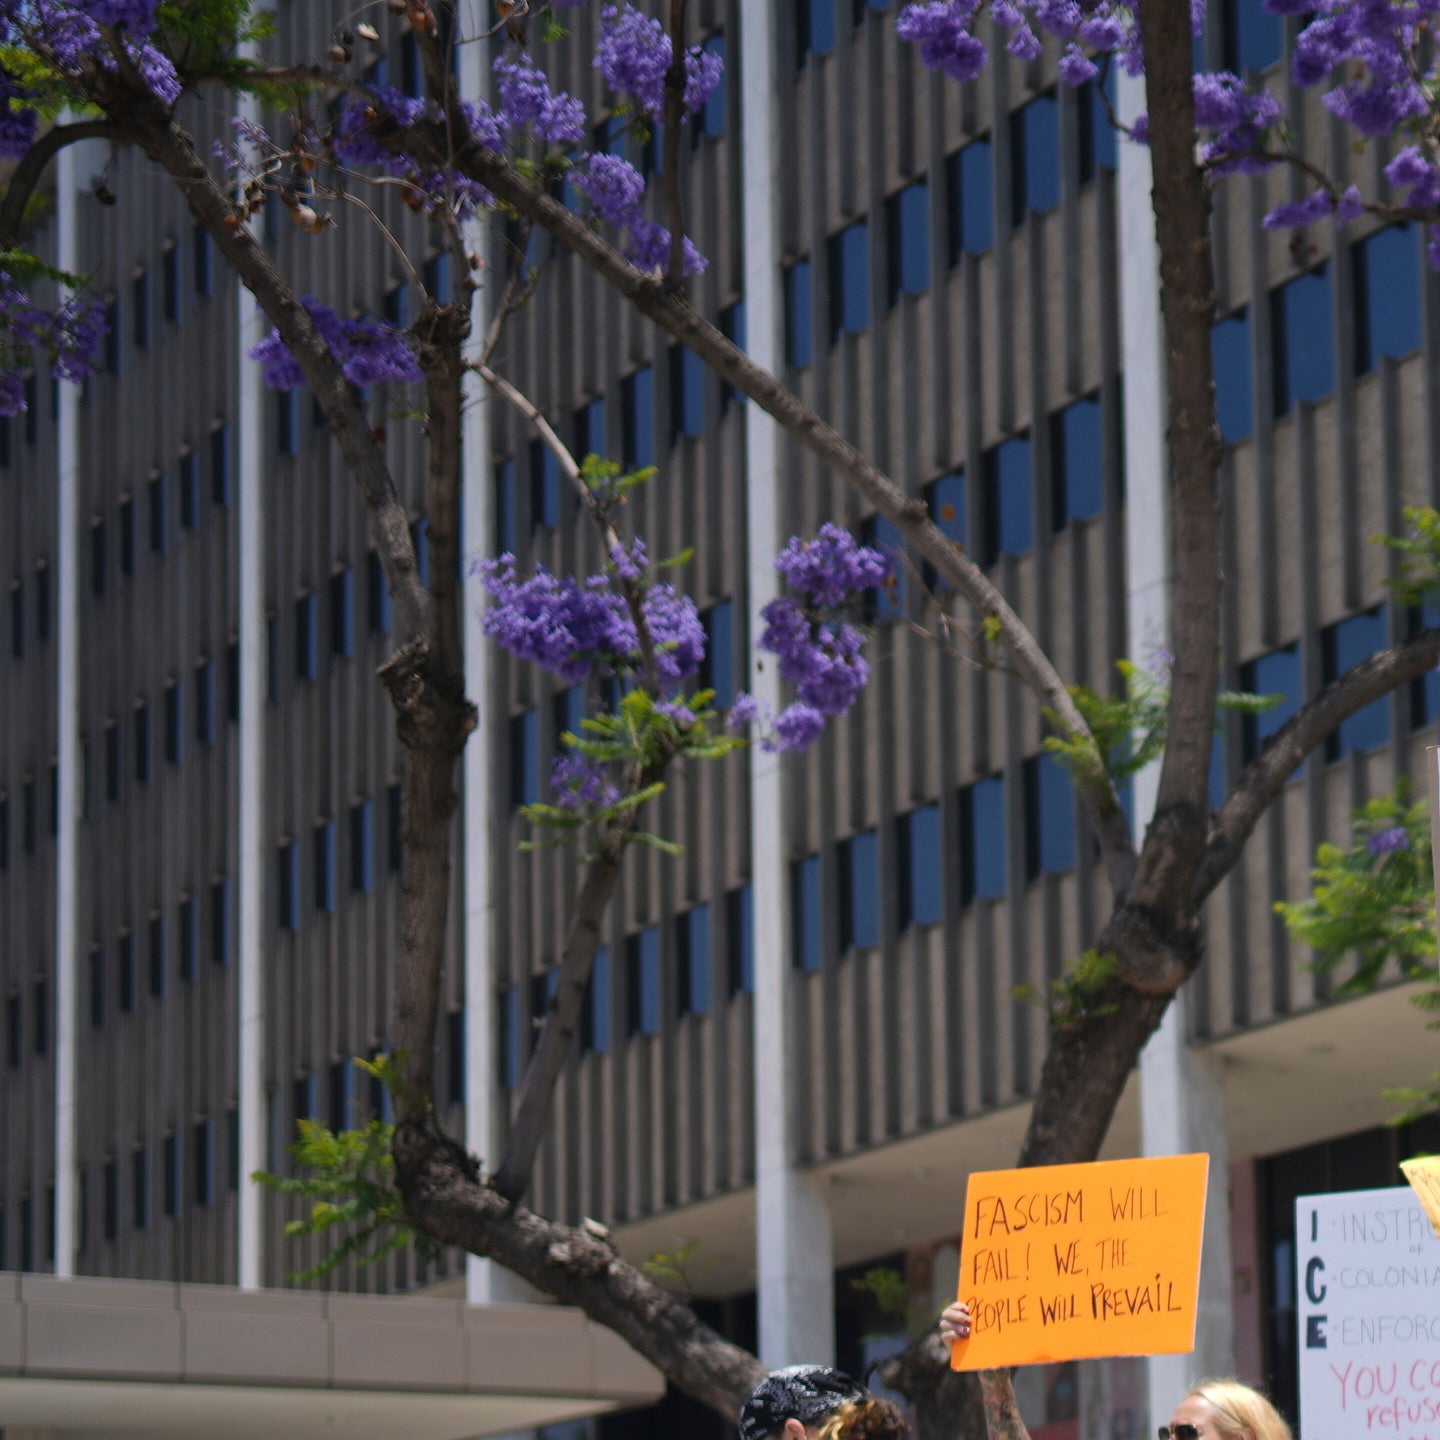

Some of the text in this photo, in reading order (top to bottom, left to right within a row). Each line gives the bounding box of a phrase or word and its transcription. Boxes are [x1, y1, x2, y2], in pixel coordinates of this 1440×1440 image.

[975, 1187, 1168, 1238] FASCISM WILL
[1311, 1209, 1318, 1242] I
[973, 1238, 1135, 1285] FAIL! WE, THE
[1305, 1256, 1327, 1305] C
[965, 1294, 1028, 1334] PEOPLE
[1306, 1315, 1327, 1349] E
